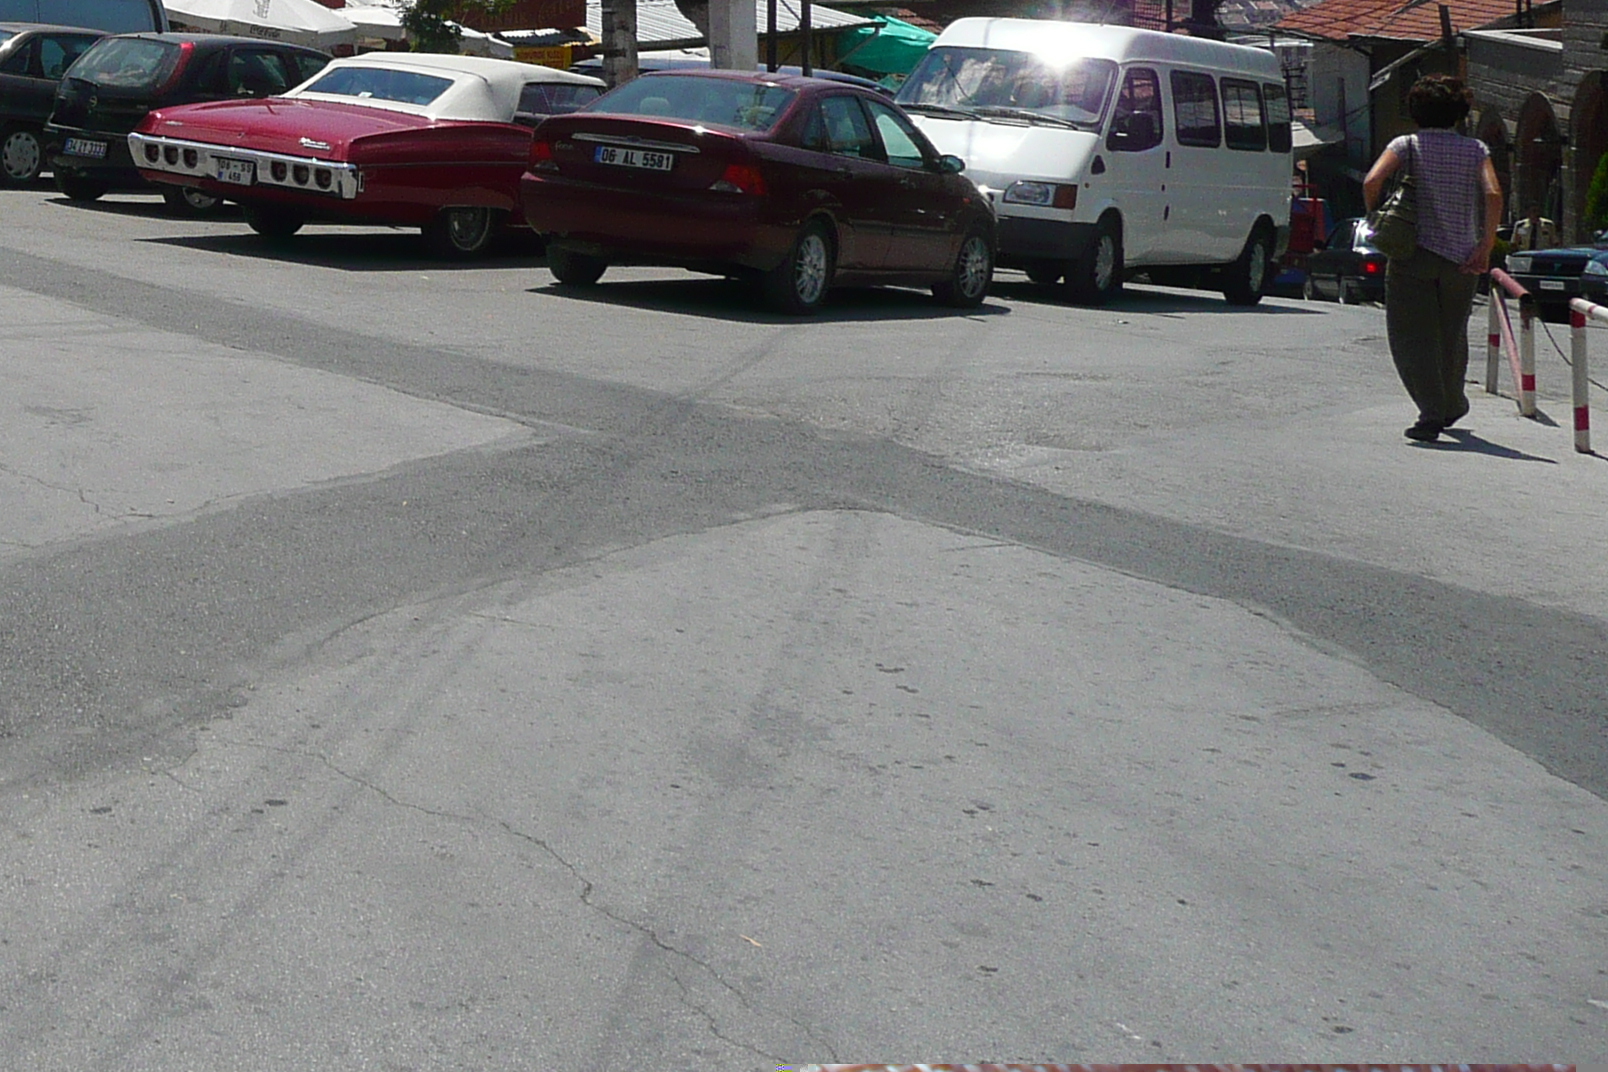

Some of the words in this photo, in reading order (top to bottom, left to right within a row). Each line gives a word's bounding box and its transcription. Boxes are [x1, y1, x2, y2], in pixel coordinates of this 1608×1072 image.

[601, 149, 618, 162] 06
[622, 151, 637, 166] AL
[642, 153, 671, 169] 5581
